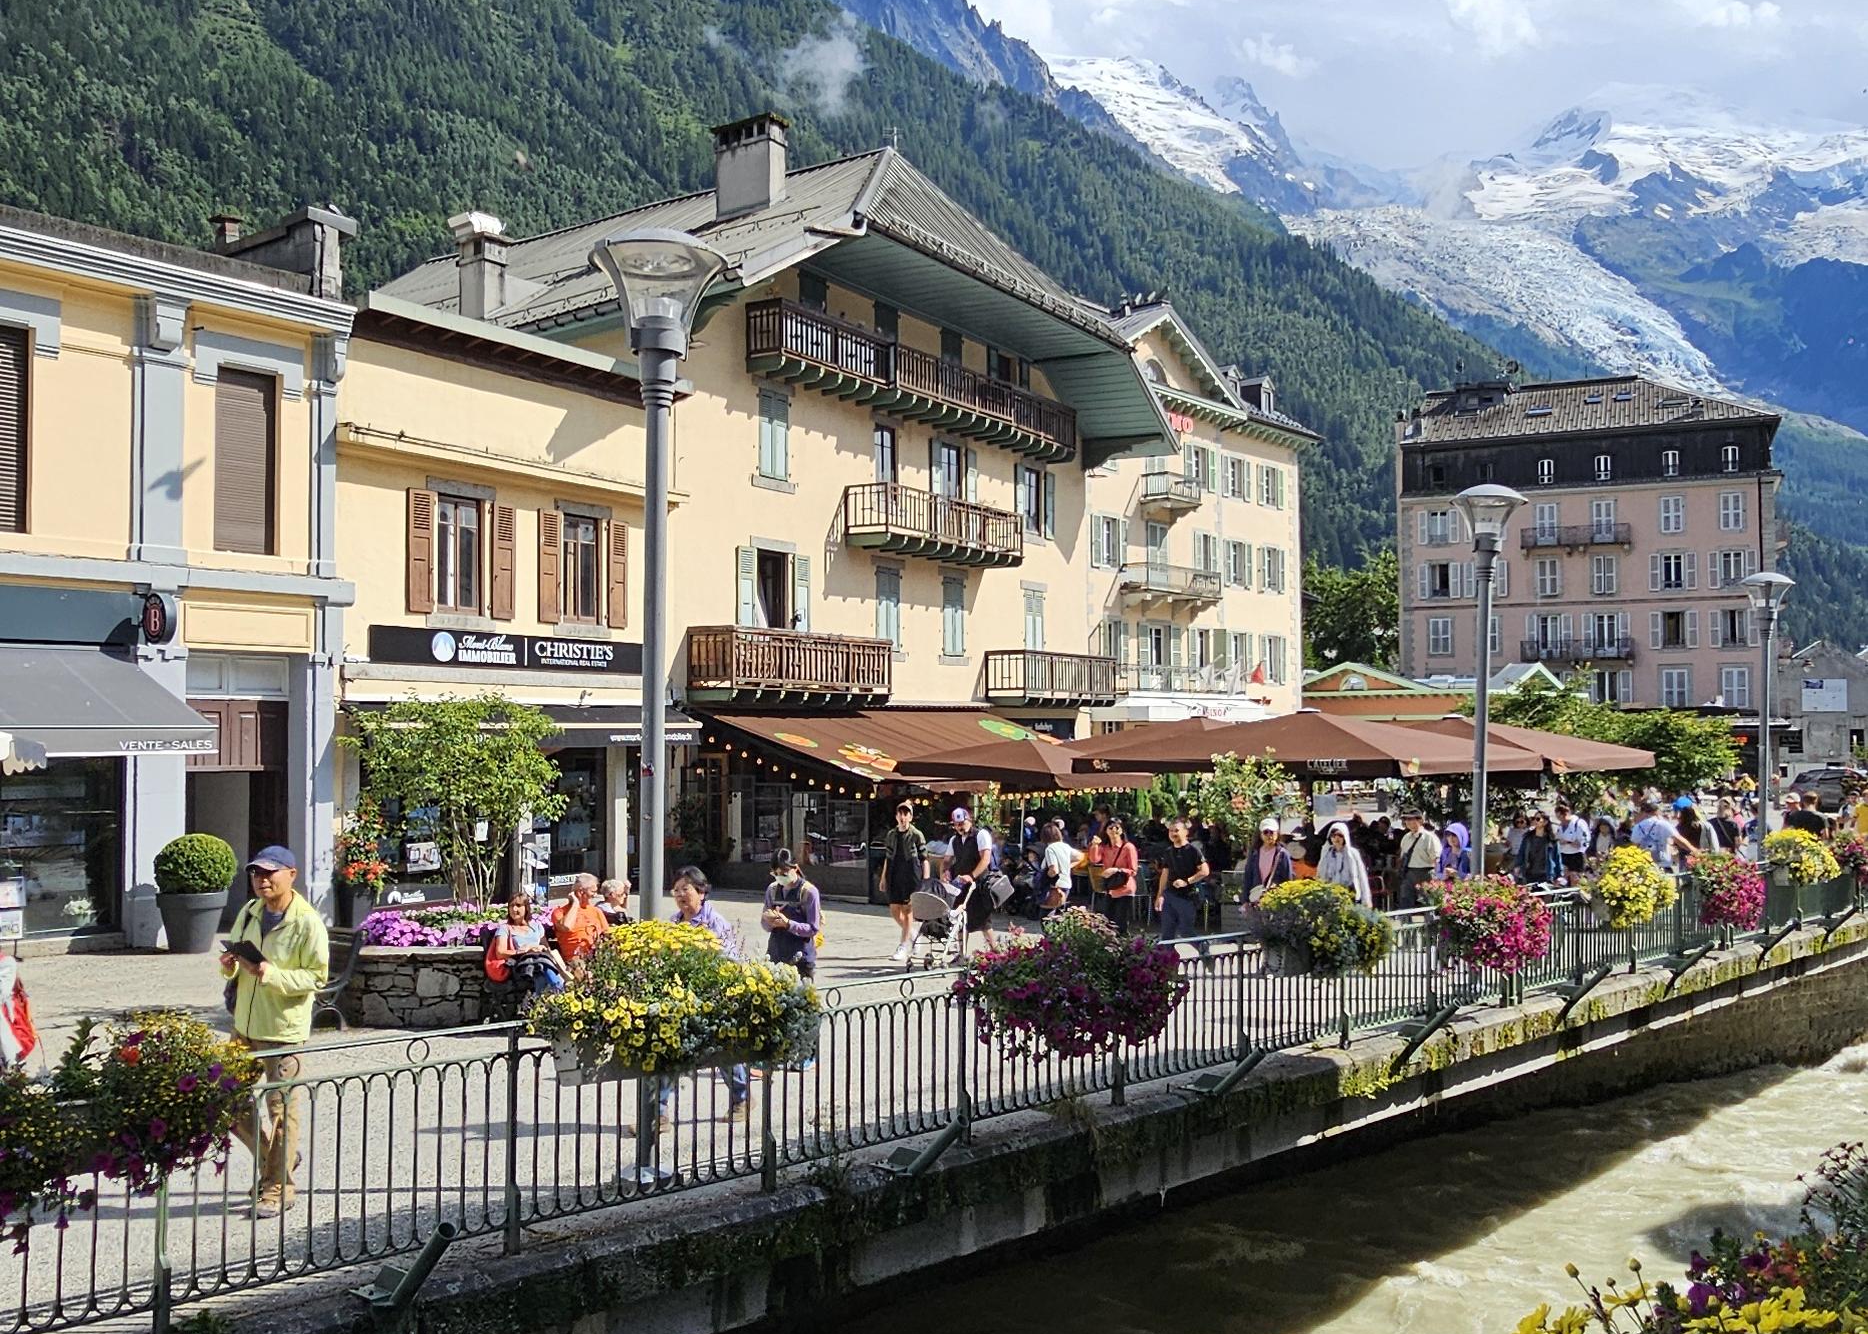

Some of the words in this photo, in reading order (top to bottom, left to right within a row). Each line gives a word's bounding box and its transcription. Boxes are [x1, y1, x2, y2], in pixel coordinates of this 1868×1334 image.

[151, 609, 160, 632] B
[458, 649, 517, 664] IMMOBILIER
[534, 641, 614, 661] CHRISTIE'S
[119, 740, 164, 751] VENTE
[171, 740, 213, 750] SALES
